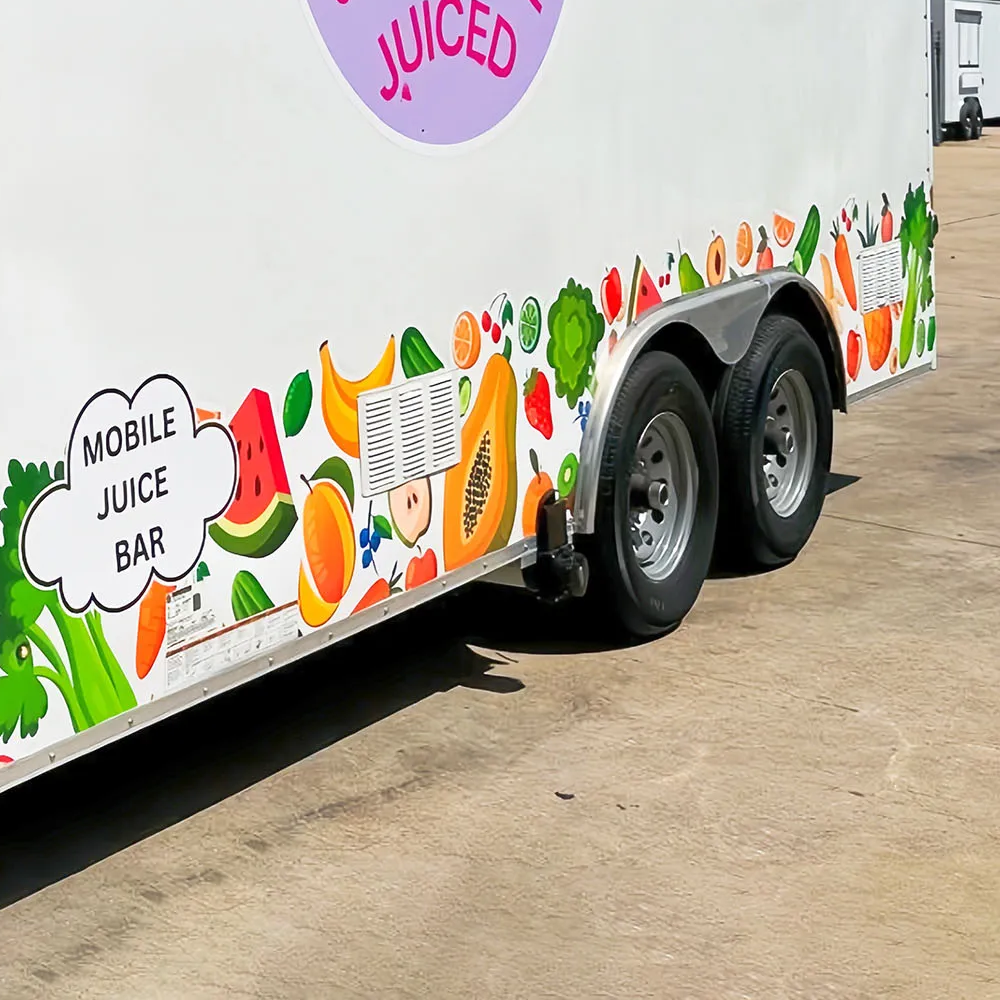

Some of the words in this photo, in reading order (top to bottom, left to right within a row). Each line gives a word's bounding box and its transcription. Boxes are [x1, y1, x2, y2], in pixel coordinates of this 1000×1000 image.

[83, 406, 177, 467] MOBILE
[97, 465, 169, 520] JUICE
[114, 525, 166, 573] BAR
